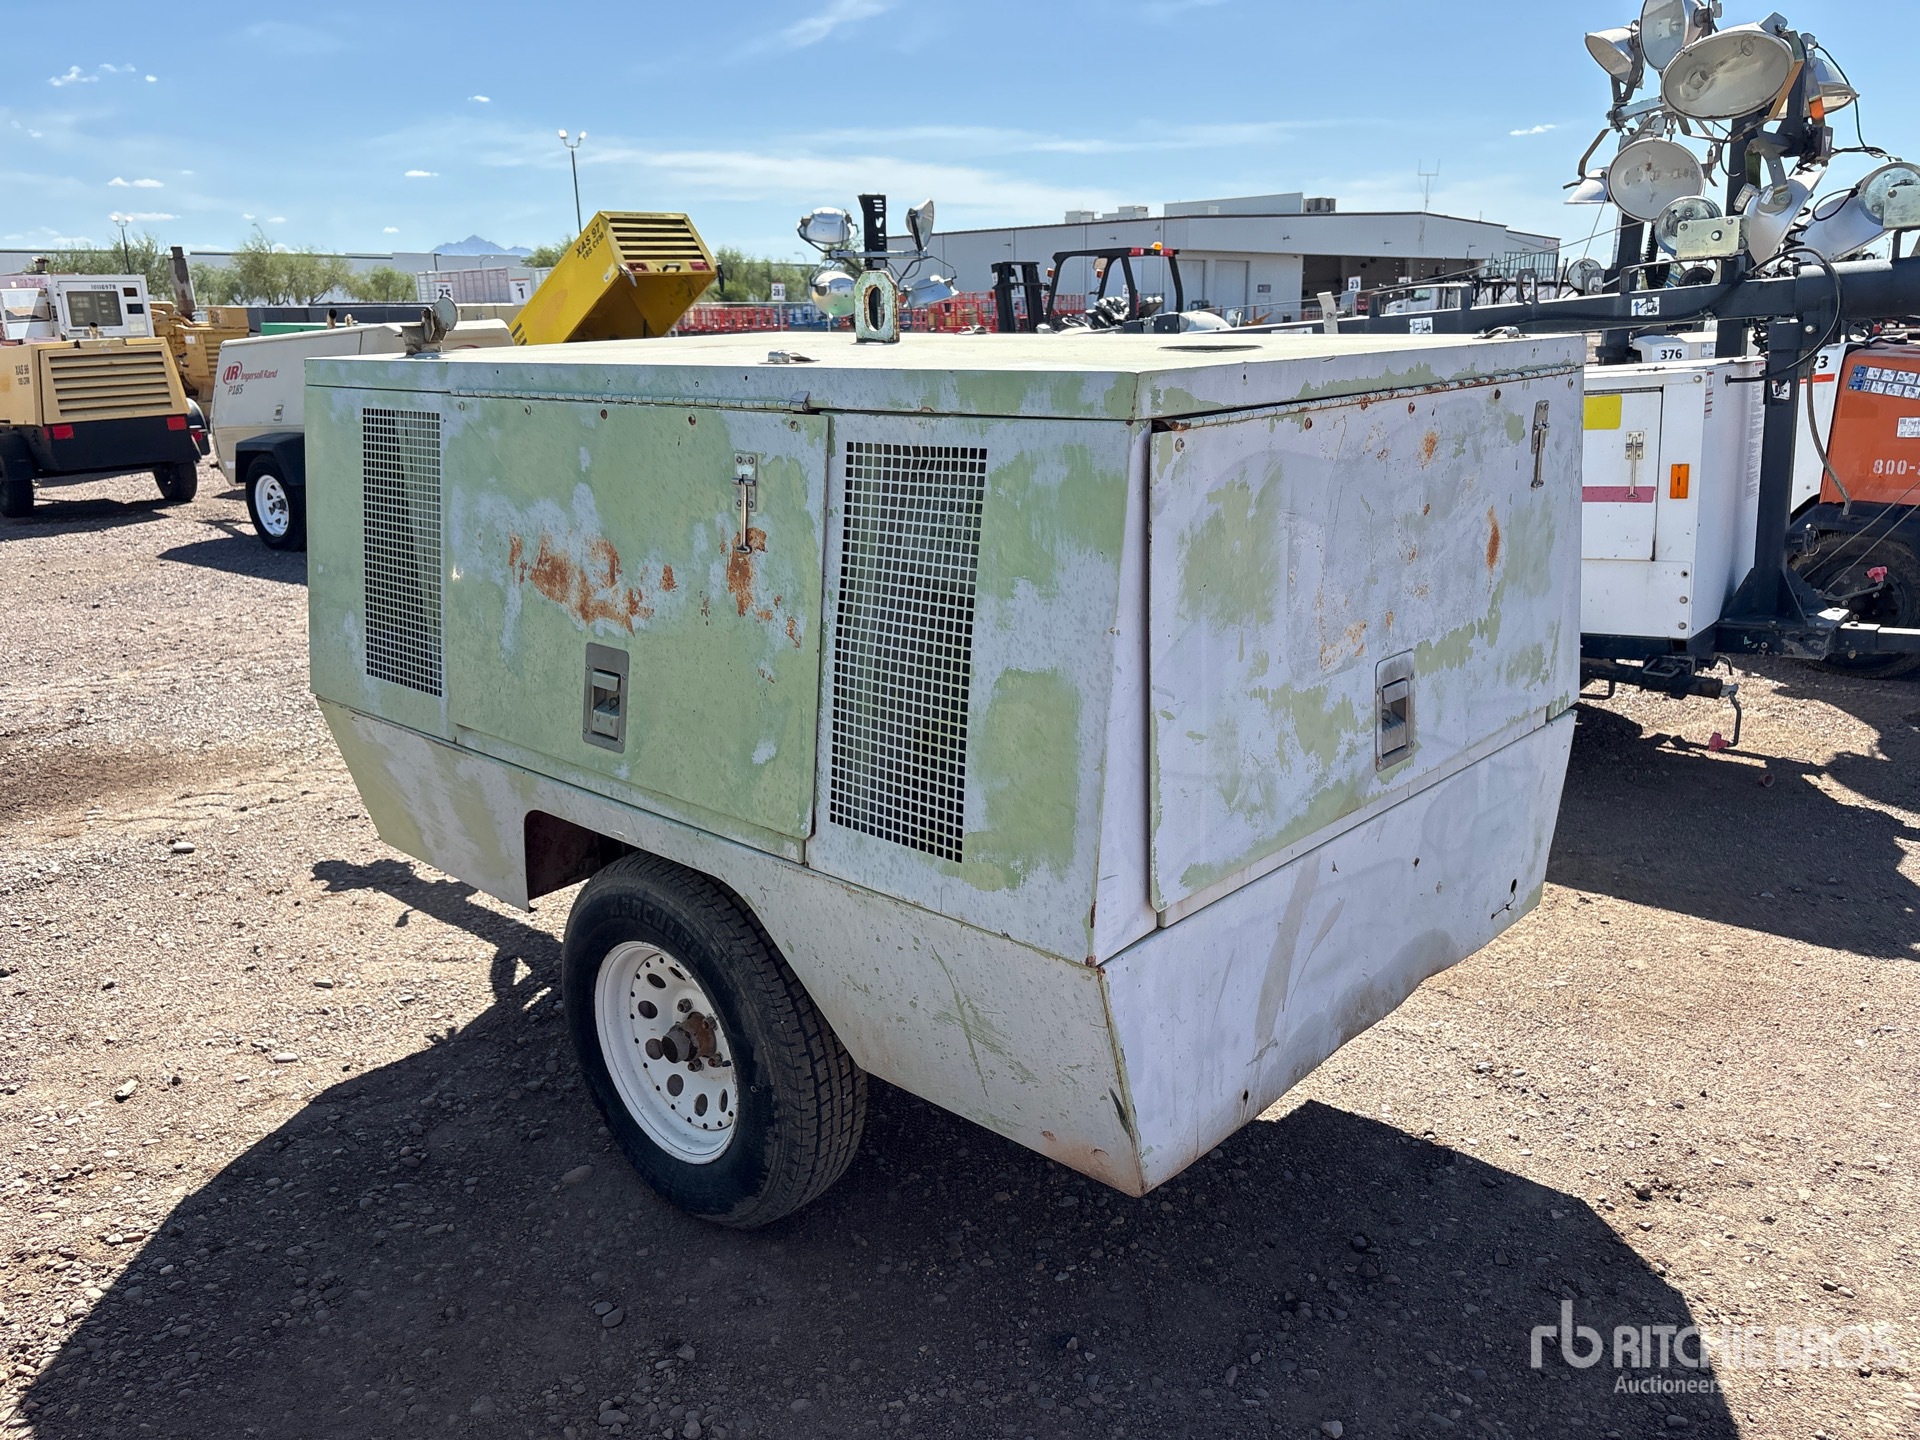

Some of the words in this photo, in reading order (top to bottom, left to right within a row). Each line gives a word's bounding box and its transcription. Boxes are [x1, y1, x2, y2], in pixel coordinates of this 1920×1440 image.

[576, 235, 591, 258] XAS
[591, 221, 601, 238] 97
[438, 288, 451, 299] 25
[518, 287, 525, 299] 1
[1660, 348, 1682, 360] 376
[225, 364, 240, 381] IR
[241, 370, 264, 382] Ingersoll
[263, 368, 278, 379] Rand
[228, 383, 244, 395] P185
[1873, 459, 1920, 476] 800-
